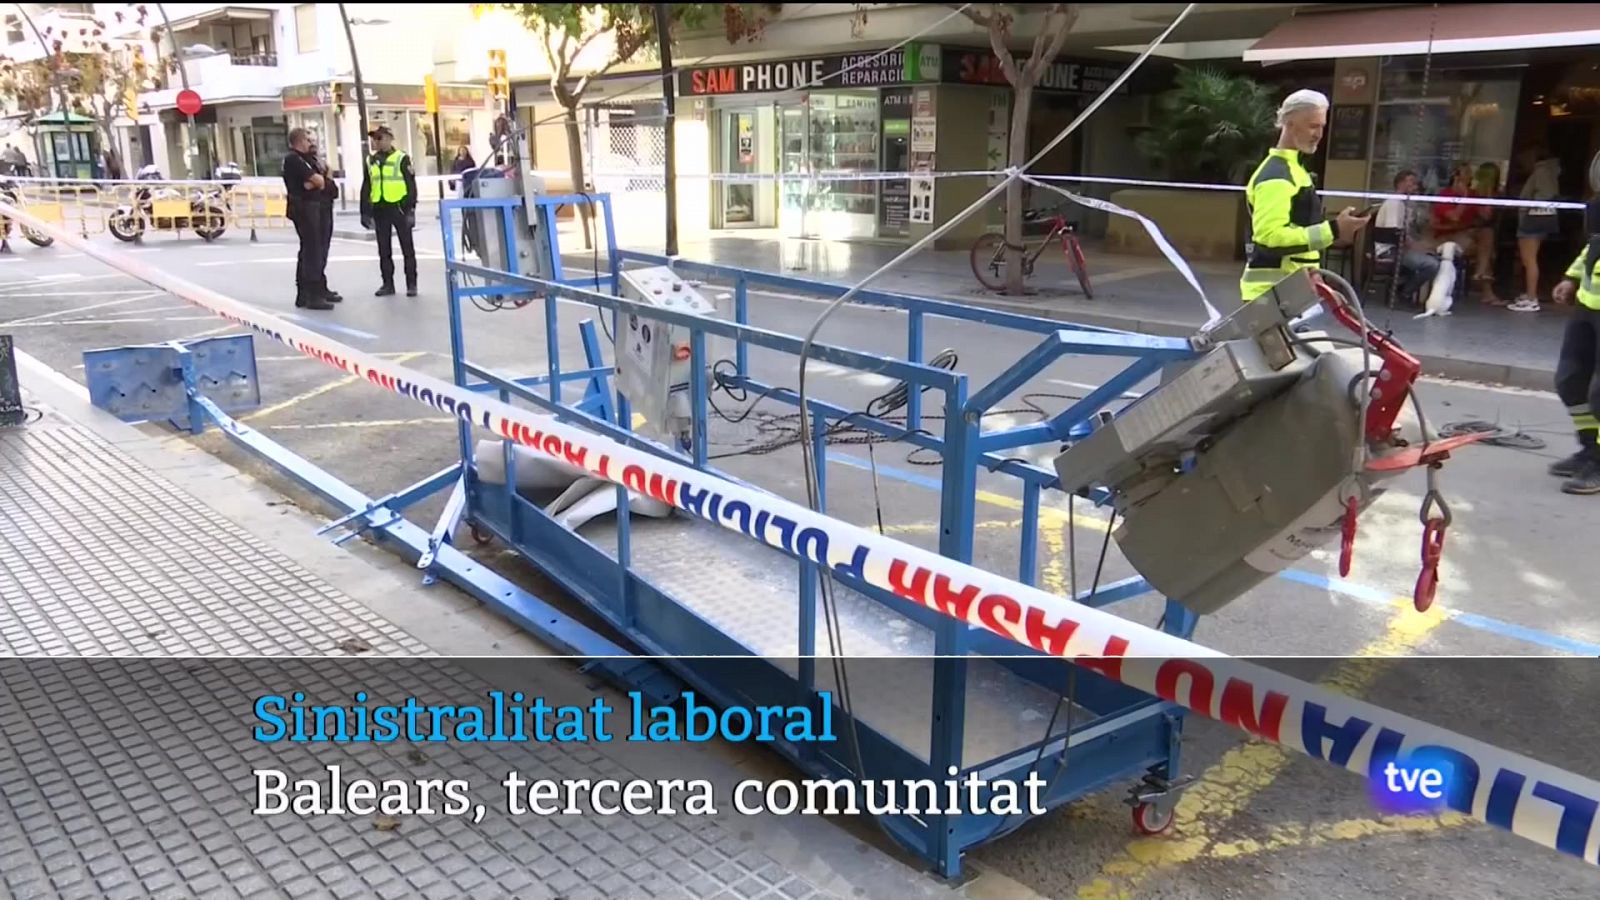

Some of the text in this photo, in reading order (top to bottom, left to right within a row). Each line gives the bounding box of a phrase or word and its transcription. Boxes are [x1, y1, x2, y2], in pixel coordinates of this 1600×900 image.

[842, 52, 905, 70] ACCESORI
[920, 55, 938, 67] ATM
[691, 60, 824, 93] SAM PHONE
[842, 69, 905, 85] REPARACI
[1301, 701, 1600, 862] LICIA
